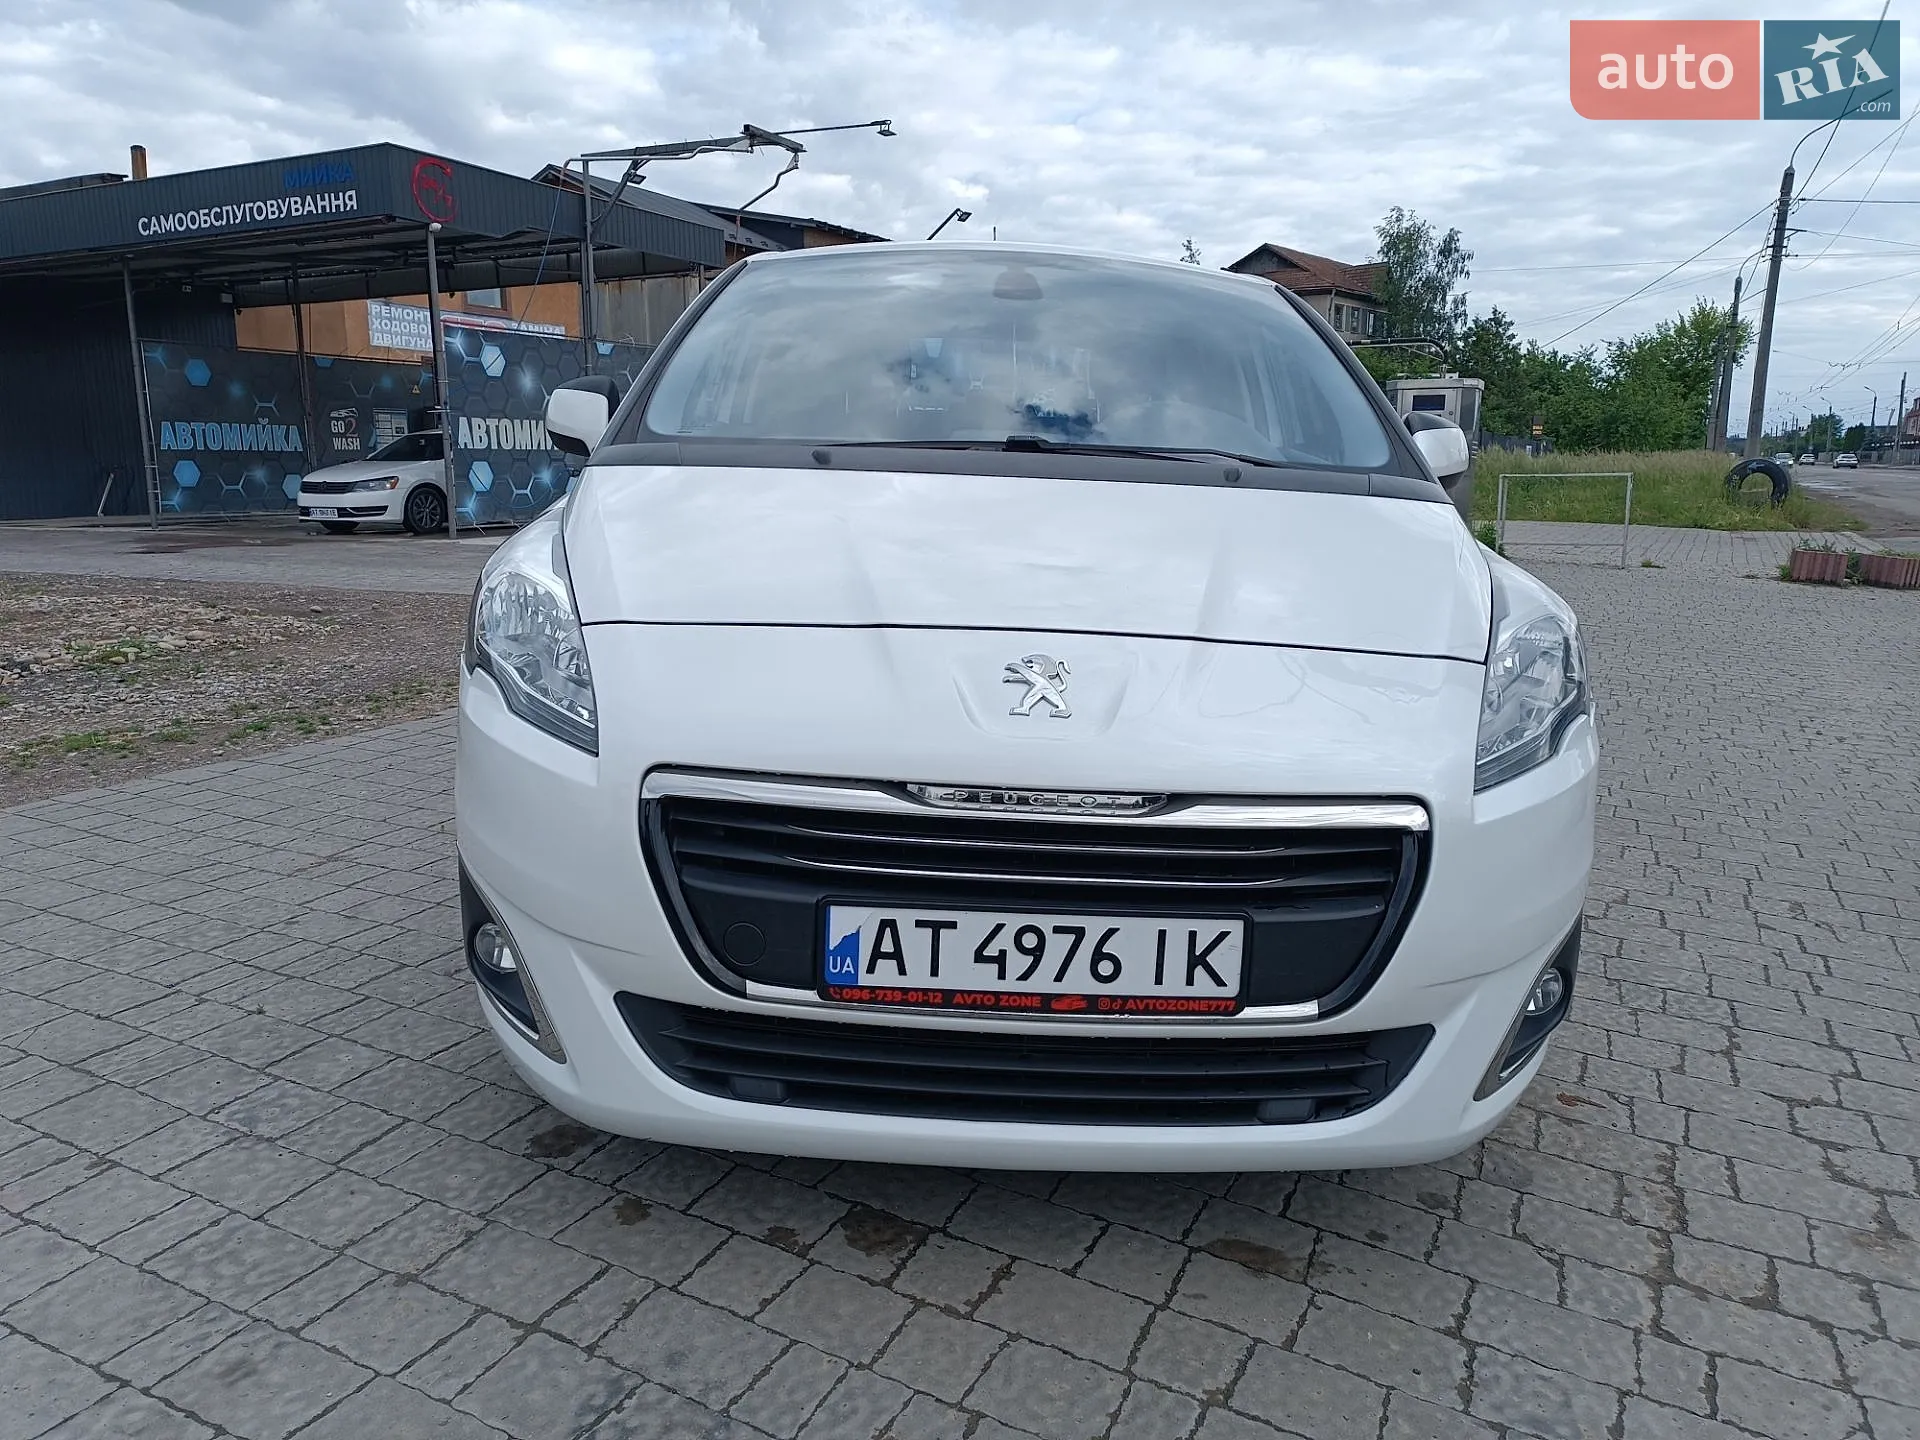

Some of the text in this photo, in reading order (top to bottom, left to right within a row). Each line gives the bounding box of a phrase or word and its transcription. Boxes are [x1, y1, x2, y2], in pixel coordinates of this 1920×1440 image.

[284, 163, 355, 188] МИЙКА
[137, 189, 359, 236] САМООБСЛУГОВУВАННЯ
[160, 417, 303, 452] АВТОМИЙКА
[332, 437, 361, 450] WASH
[949, 789, 1125, 808] PEUGEOT
[828, 955, 855, 974] UA
[865, 918, 1232, 988] AT 4976 IK
[842, 988, 1237, 1012] 096-739-01-12 AVTO ZONE AVTOZONE777
